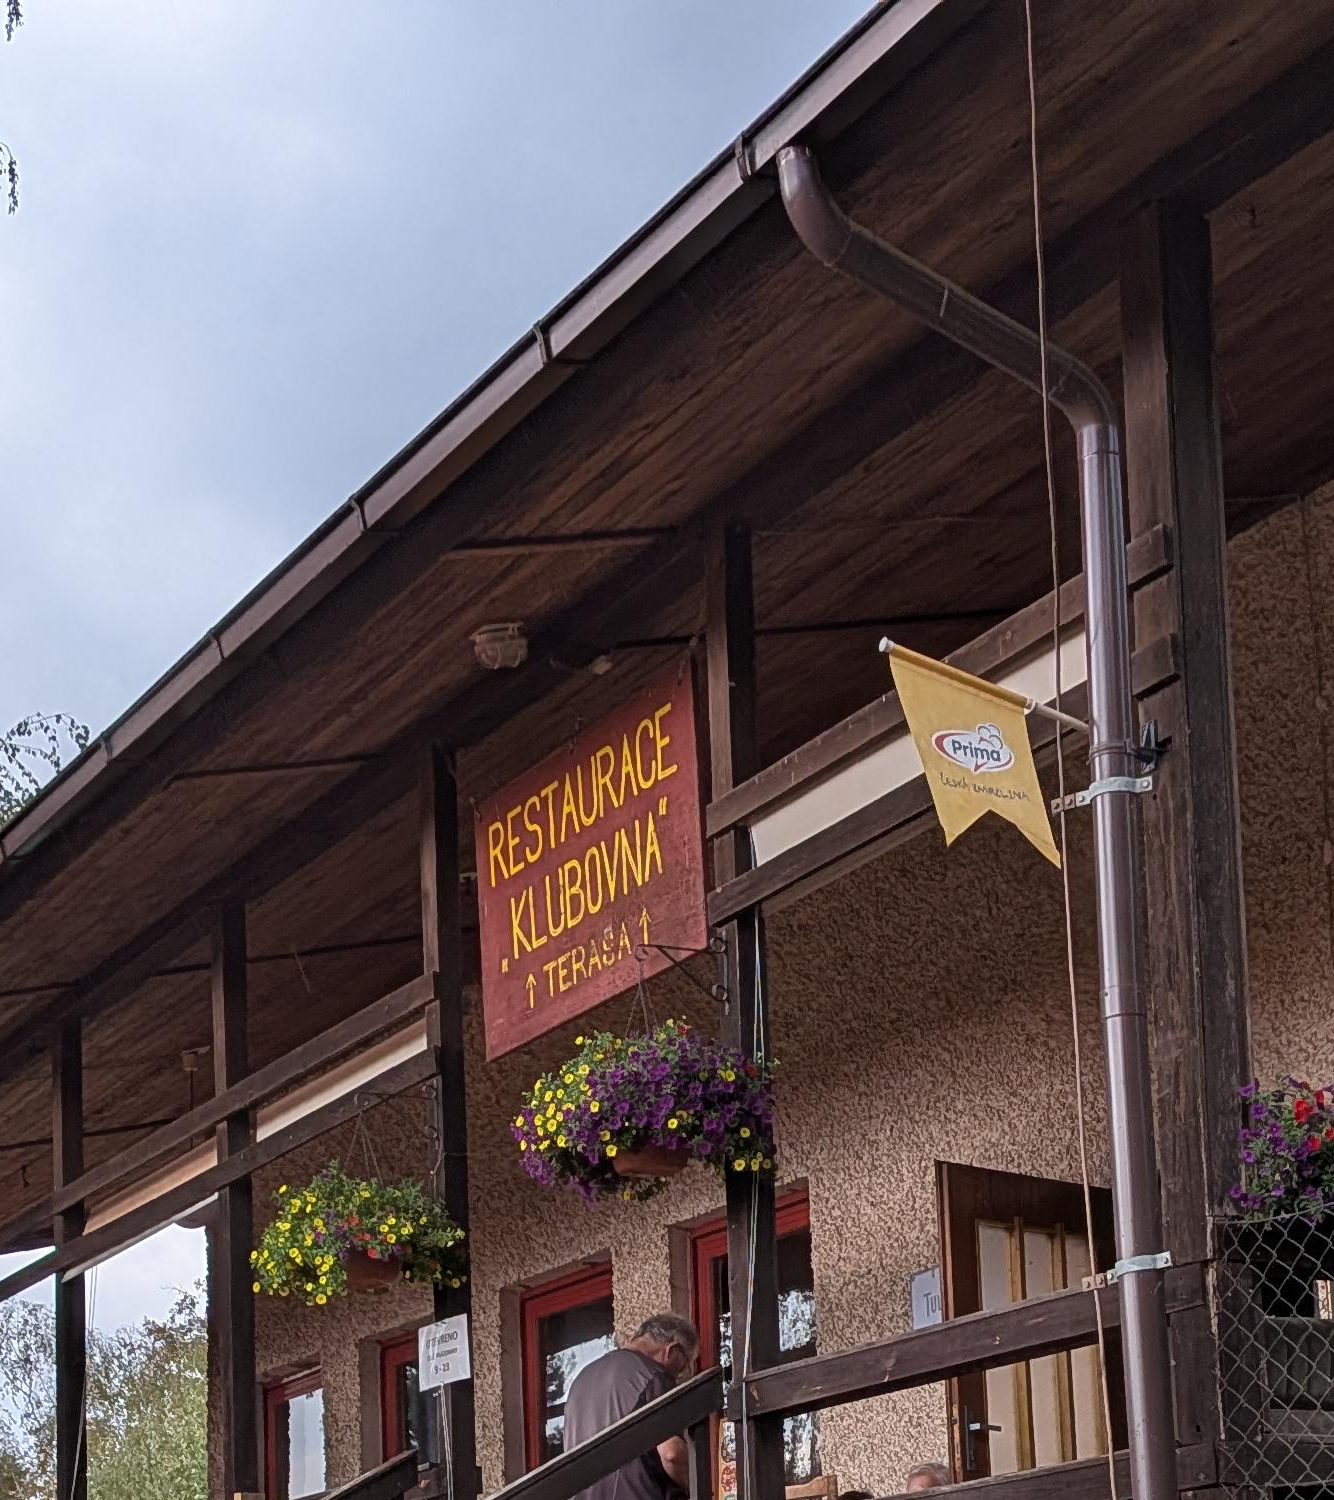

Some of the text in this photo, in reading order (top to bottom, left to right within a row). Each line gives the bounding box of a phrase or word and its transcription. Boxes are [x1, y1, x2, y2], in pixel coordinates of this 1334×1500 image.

[951, 738, 1002, 762] Prima
[487, 702, 679, 888] RESTAURACE
[543, 921, 633, 998] TERASA
